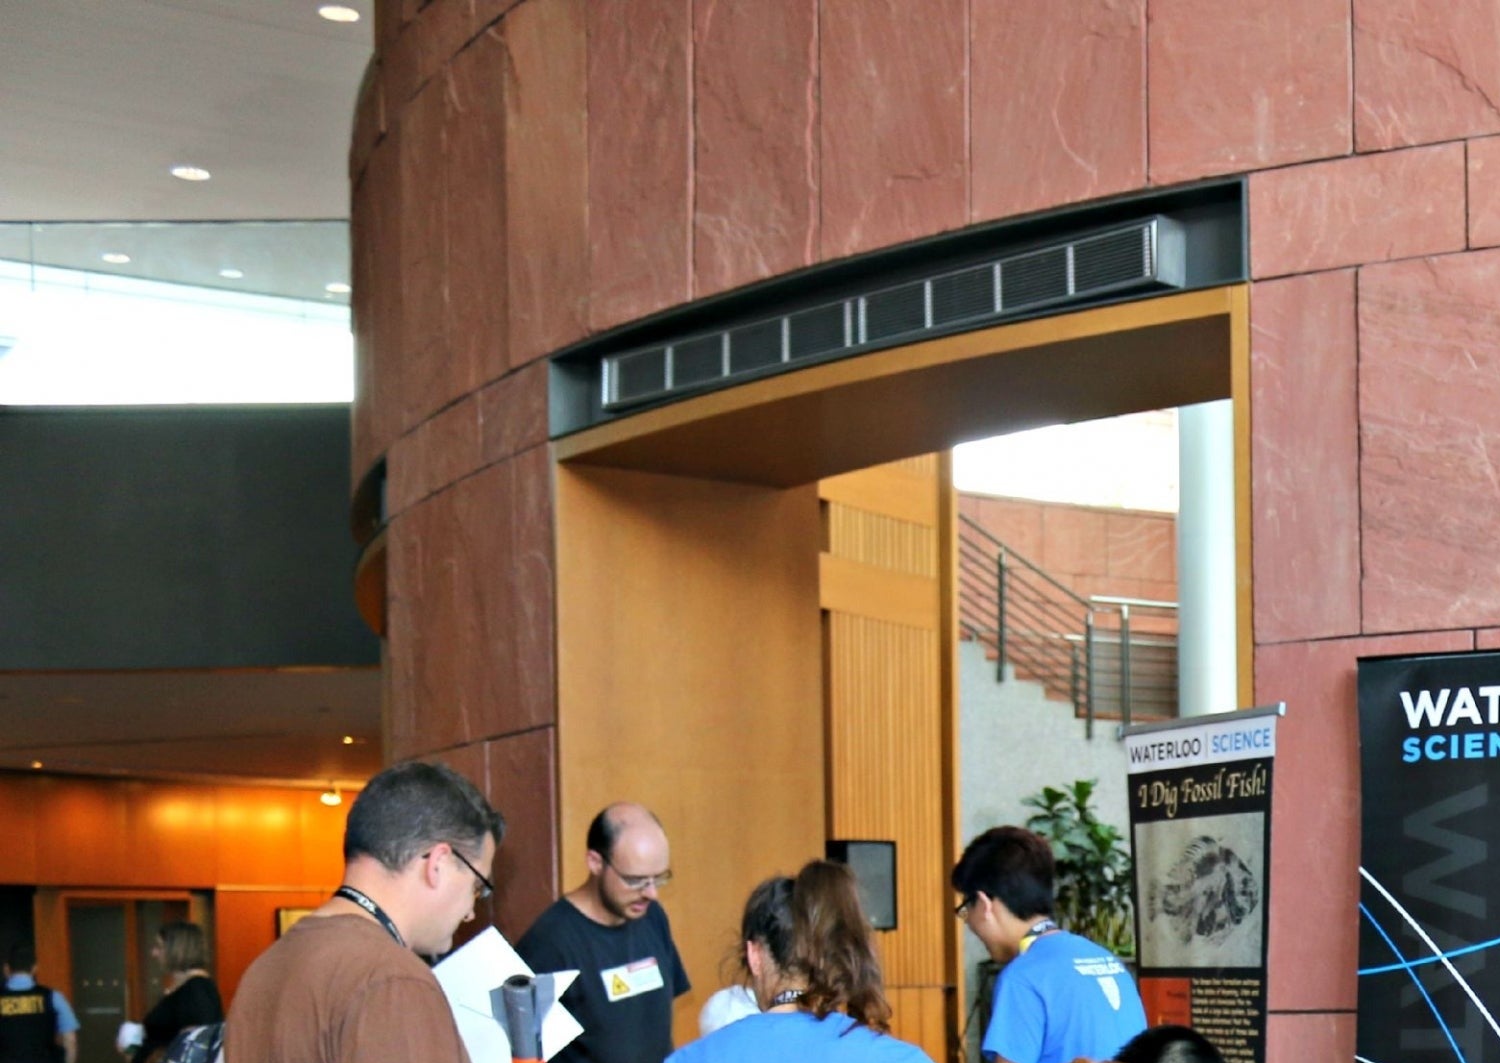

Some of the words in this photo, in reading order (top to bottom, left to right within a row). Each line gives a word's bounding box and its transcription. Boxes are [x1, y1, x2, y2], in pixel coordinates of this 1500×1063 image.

[1129, 738, 1202, 764] WATERLOO
[1212, 728, 1271, 754] SCIENCE
[1138, 783, 1148, 808] I
[1150, 780, 1179, 818] Dig
[1181, 767, 1226, 804] Fossil
[1226, 763, 1267, 798] Fish!
